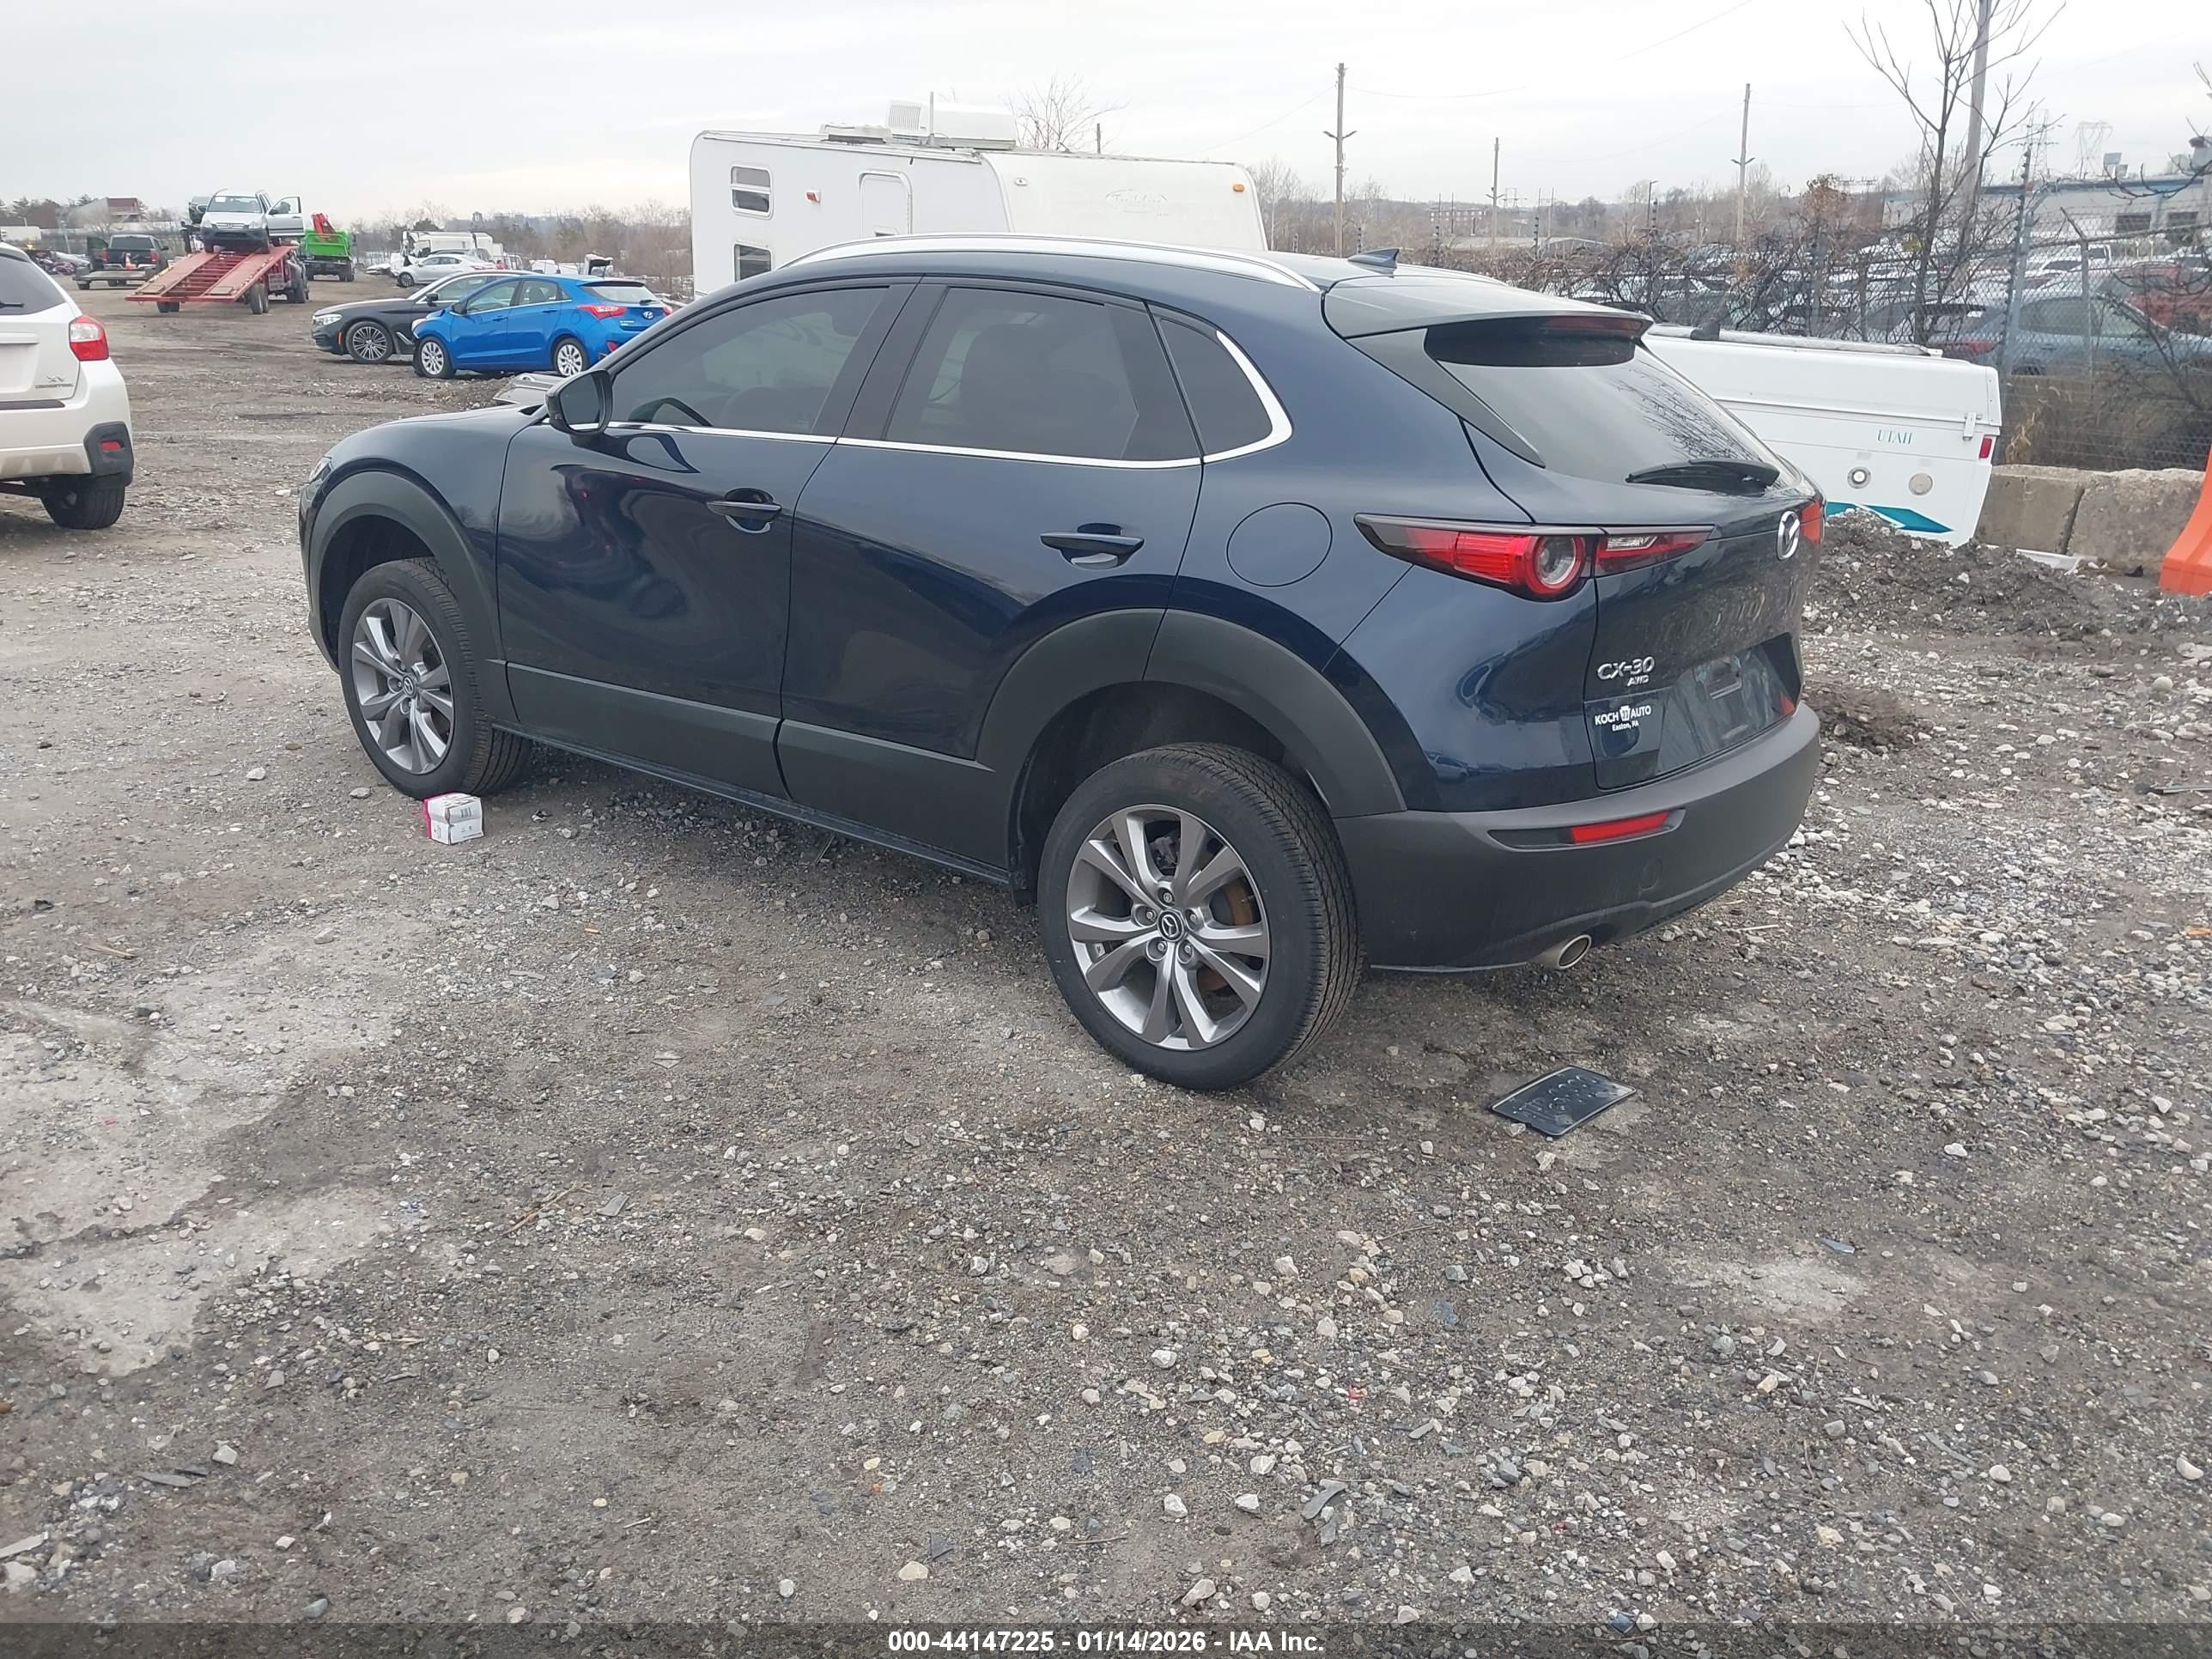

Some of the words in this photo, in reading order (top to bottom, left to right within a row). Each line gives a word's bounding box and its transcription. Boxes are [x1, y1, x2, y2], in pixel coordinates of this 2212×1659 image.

[1877, 428, 1913, 445] UTAH
[1597, 656, 1655, 680] CX-30
[1626, 674, 1650, 687] AWD
[1595, 711, 1620, 726] KOCH
[1630, 705, 1652, 720] AUTO
[1612, 722, 1632, 732] Easton,
[1632, 720, 1639, 728] PA
